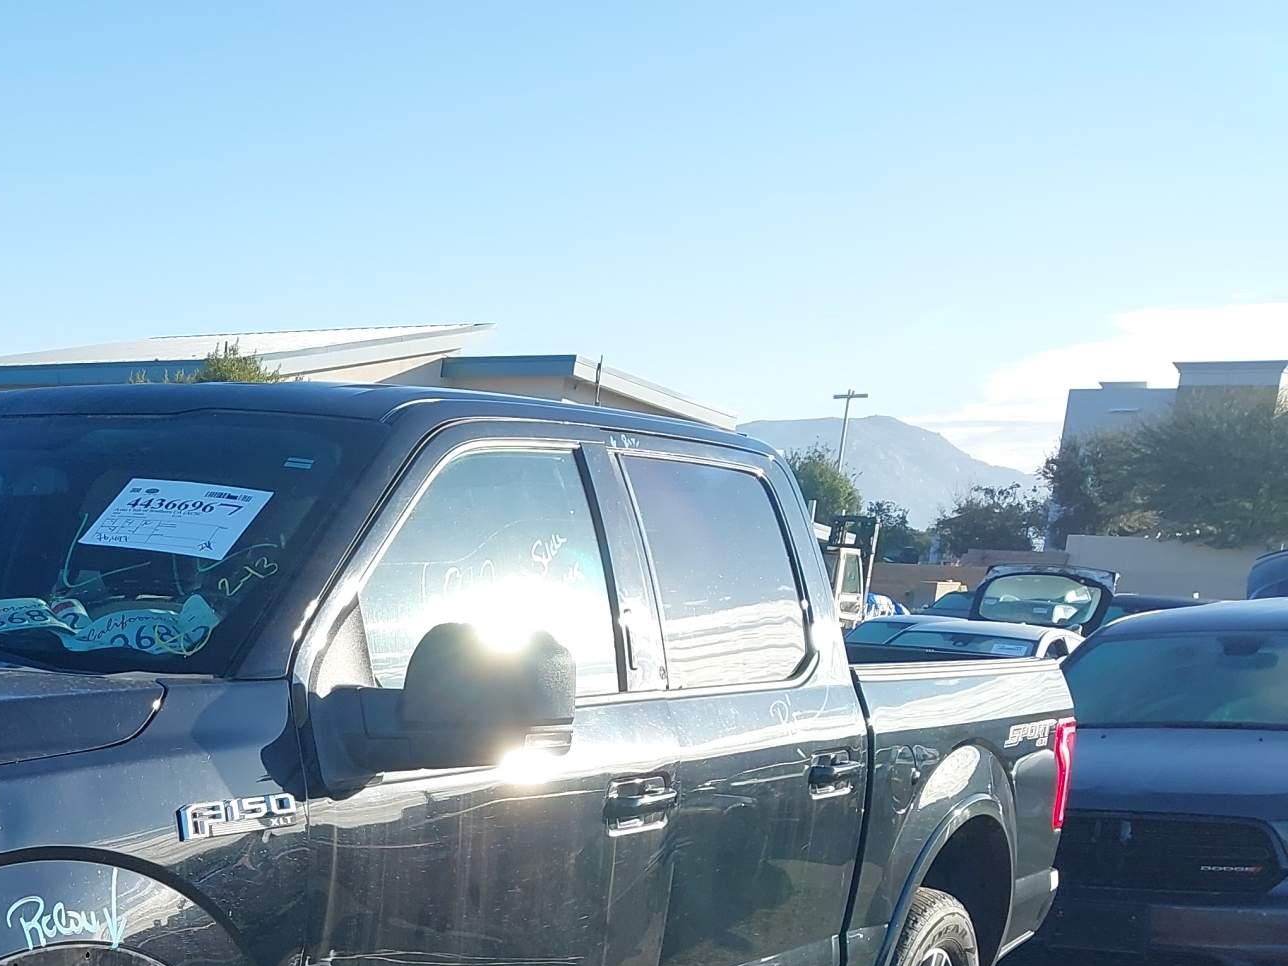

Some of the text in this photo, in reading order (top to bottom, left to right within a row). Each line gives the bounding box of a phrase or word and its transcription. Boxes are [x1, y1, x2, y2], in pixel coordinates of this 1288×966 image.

[126, 497, 244, 516] 44366967
[1004, 719, 1058, 748] SPORT
[269, 816, 293, 827] XLT
